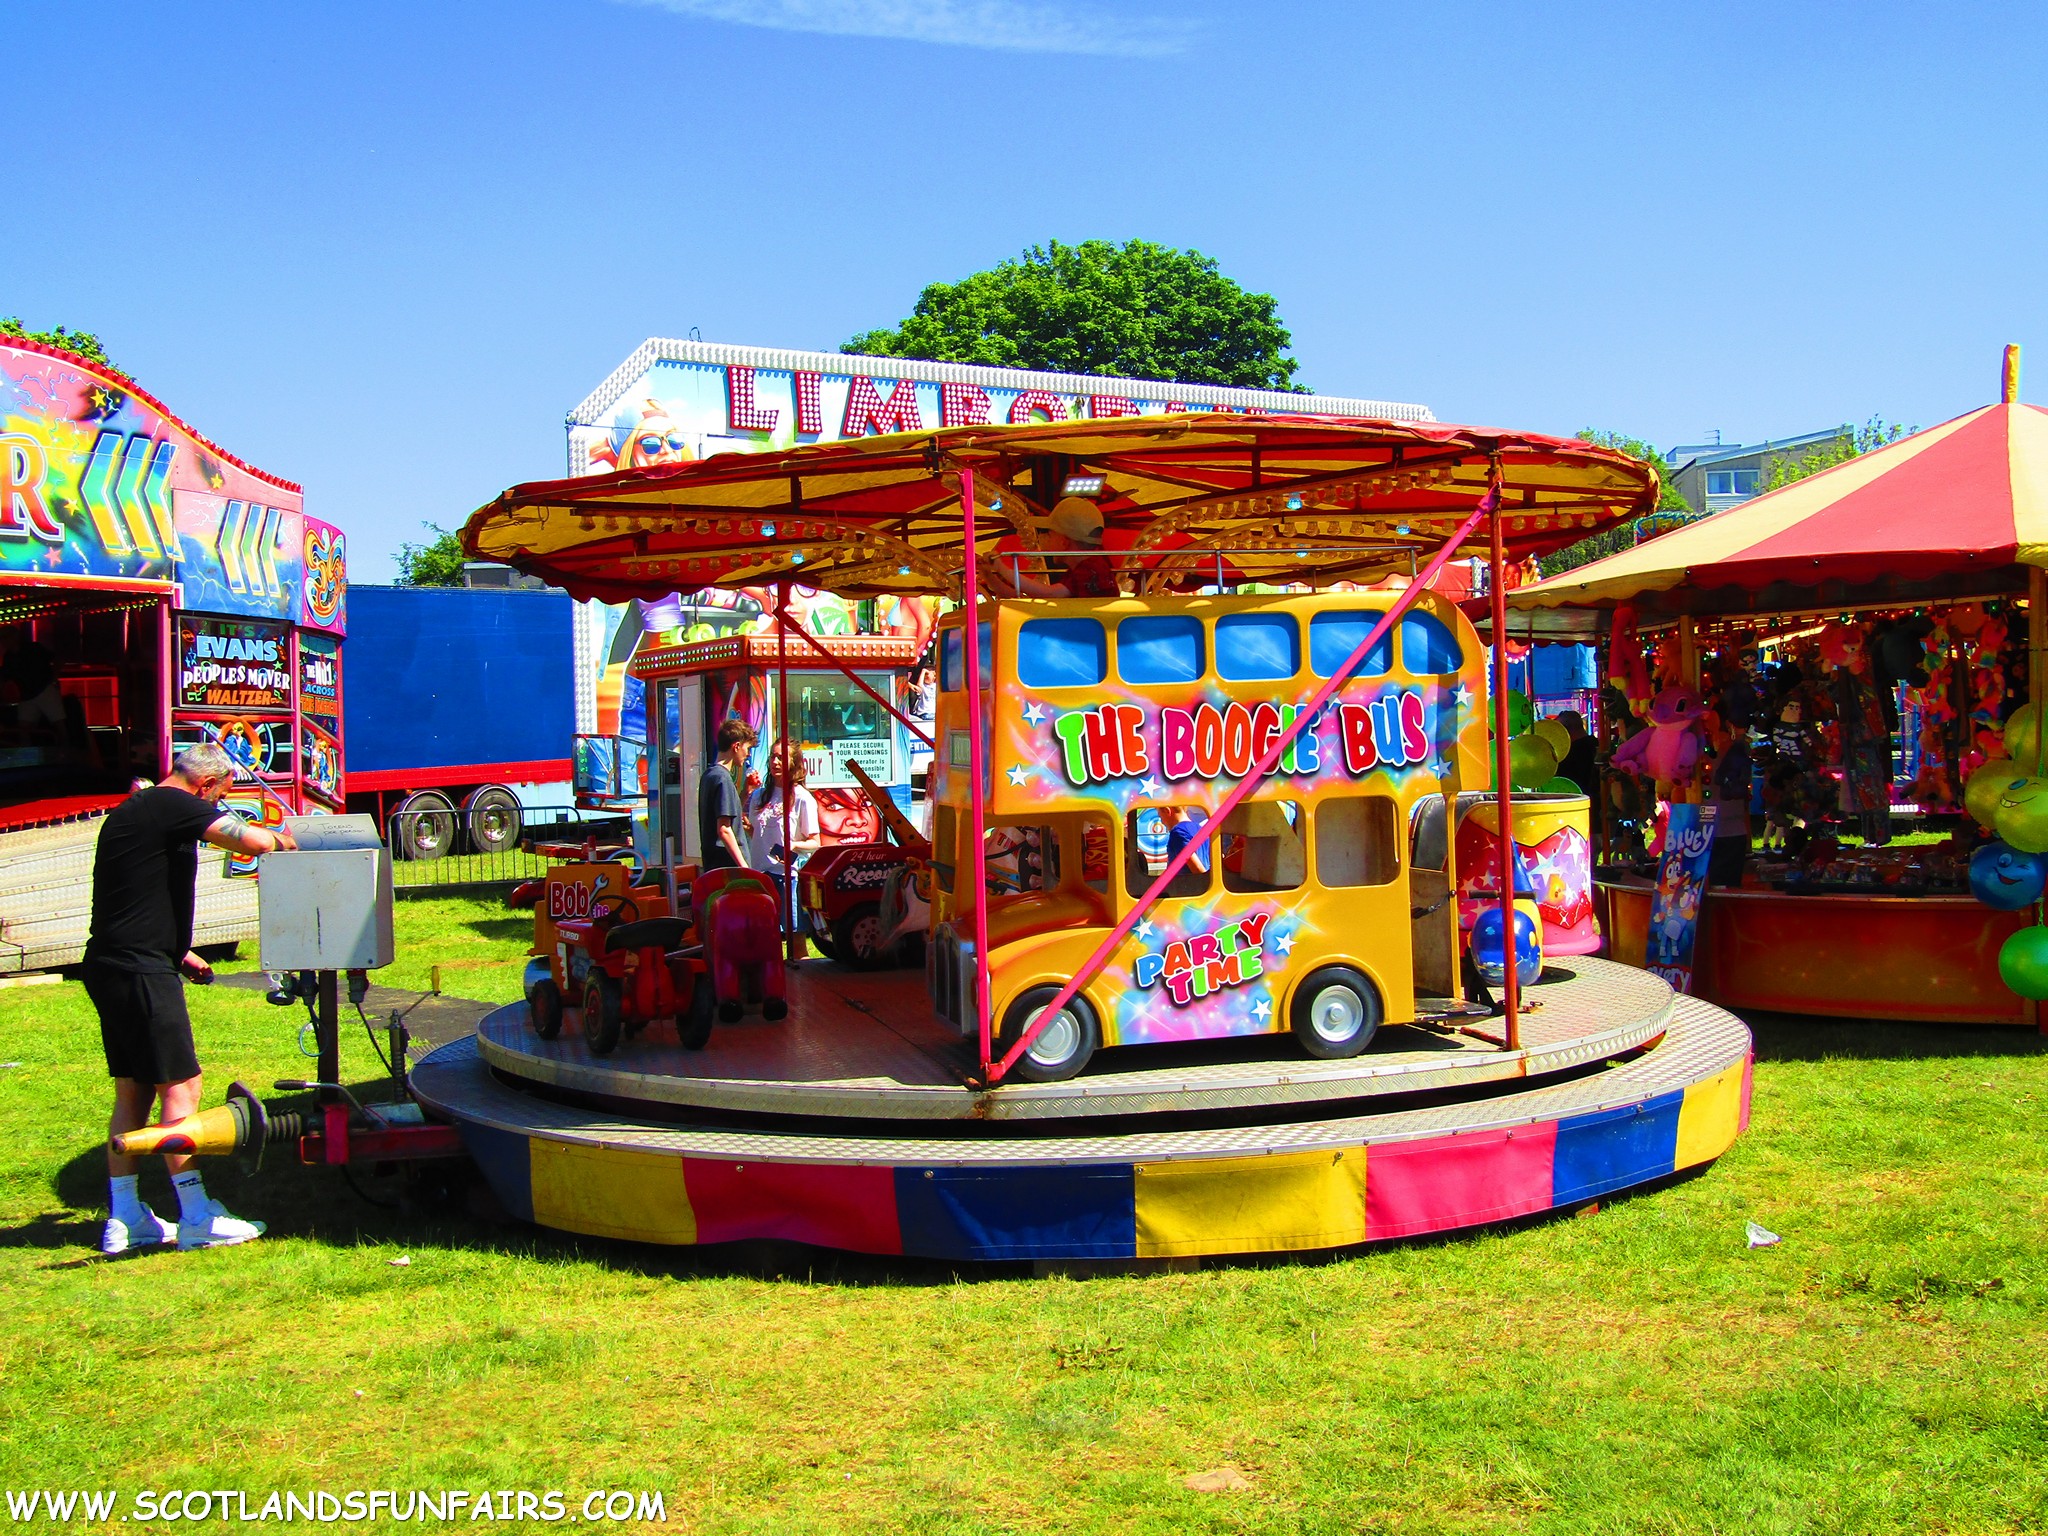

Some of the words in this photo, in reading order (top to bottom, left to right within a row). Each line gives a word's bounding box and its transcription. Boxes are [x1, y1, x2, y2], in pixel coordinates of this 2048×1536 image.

[219, 623, 255, 637] IT'S
[196, 635, 278, 662] EVANS
[183, 662, 246, 689] PEOPLES
[247, 667, 291, 690] MOVER
[207, 688, 272, 706] WALTZER
[304, 683, 335, 697] ACROSS
[1055, 703, 1149, 784] THE
[1161, 702, 1320, 780] BOOGIE
[1341, 693, 1429, 774] BUS
[1664, 825, 1714, 858] BLUEY
[850, 851, 865, 861] 24
[866, 850, 887, 860] hour
[550, 881, 590, 917] Bob
[560, 929, 580, 941] TURBO
[1136, 913, 1270, 987] PARTY
[1166, 947, 1264, 1004] TIME
